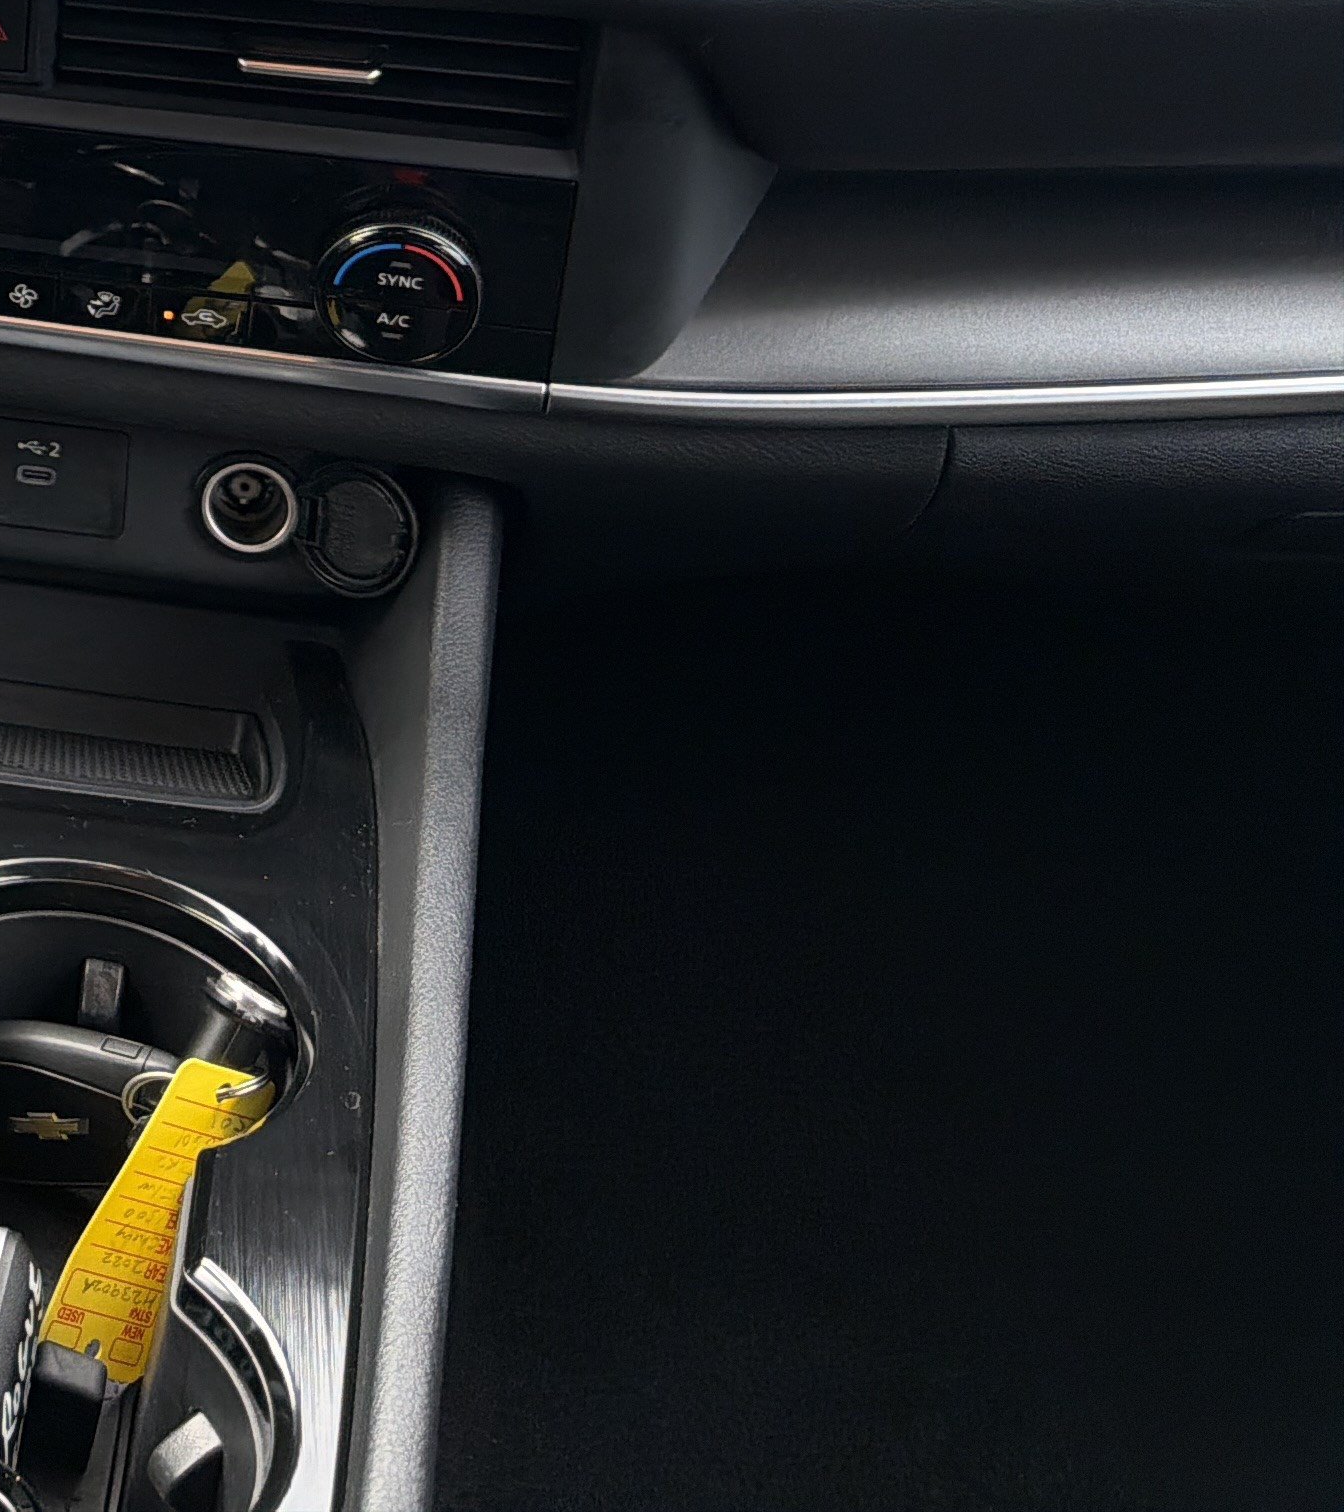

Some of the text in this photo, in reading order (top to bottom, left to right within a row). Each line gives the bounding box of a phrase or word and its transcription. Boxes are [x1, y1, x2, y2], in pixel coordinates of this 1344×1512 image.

[377, 272, 425, 292] SYNC
[376, 310, 411, 329] A/C
[48, 442, 61, 458] 2
[143, 1261, 169, 1284] EAR
[57, 1306, 86, 1325] USED
[120, 1323, 147, 1341] NEW
